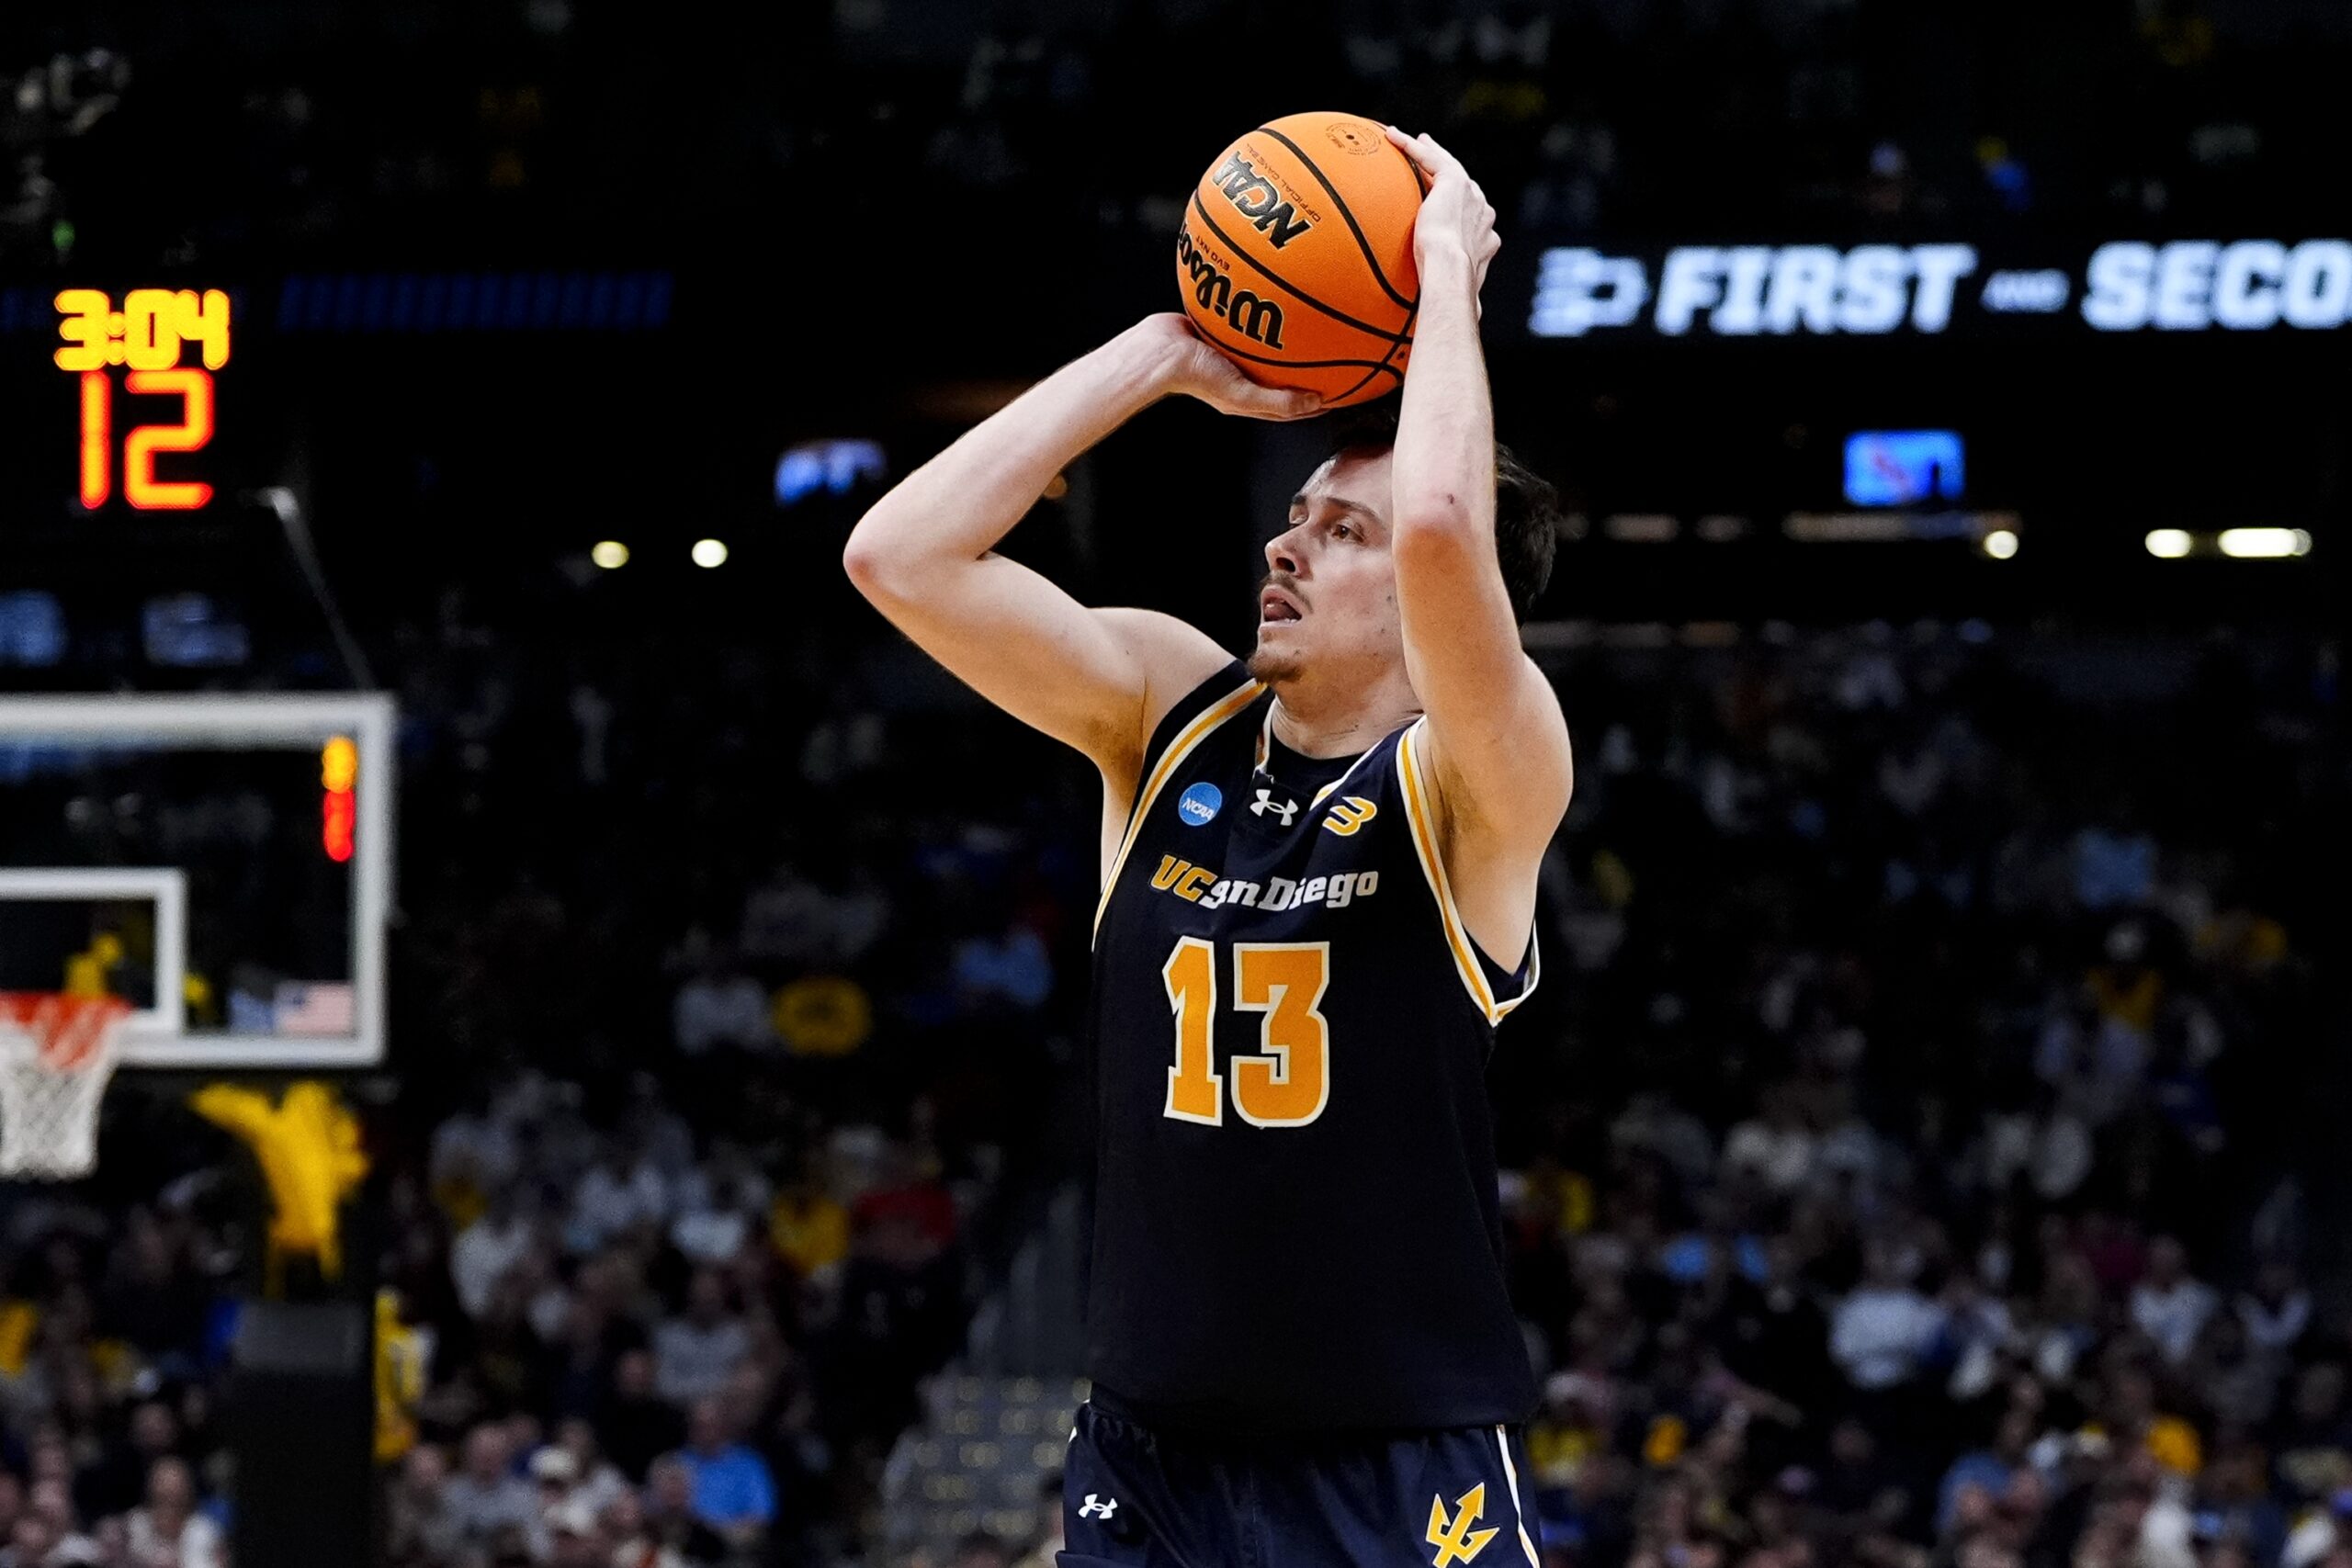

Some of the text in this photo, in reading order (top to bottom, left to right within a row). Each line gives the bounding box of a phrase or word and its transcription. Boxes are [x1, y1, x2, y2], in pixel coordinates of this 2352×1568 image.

[1212, 150, 1314, 250] NCAA
[54, 289, 230, 371] 3:04
[1178, 220, 1284, 351] Wilso
[1654, 244, 1977, 336] FIRST
[80, 368, 212, 509] 12
[1182, 796, 1215, 820] NCAA
[1150, 854, 1218, 902] UC
[1257, 870, 1378, 911] Diego
[1162, 935, 1330, 1129] 13
